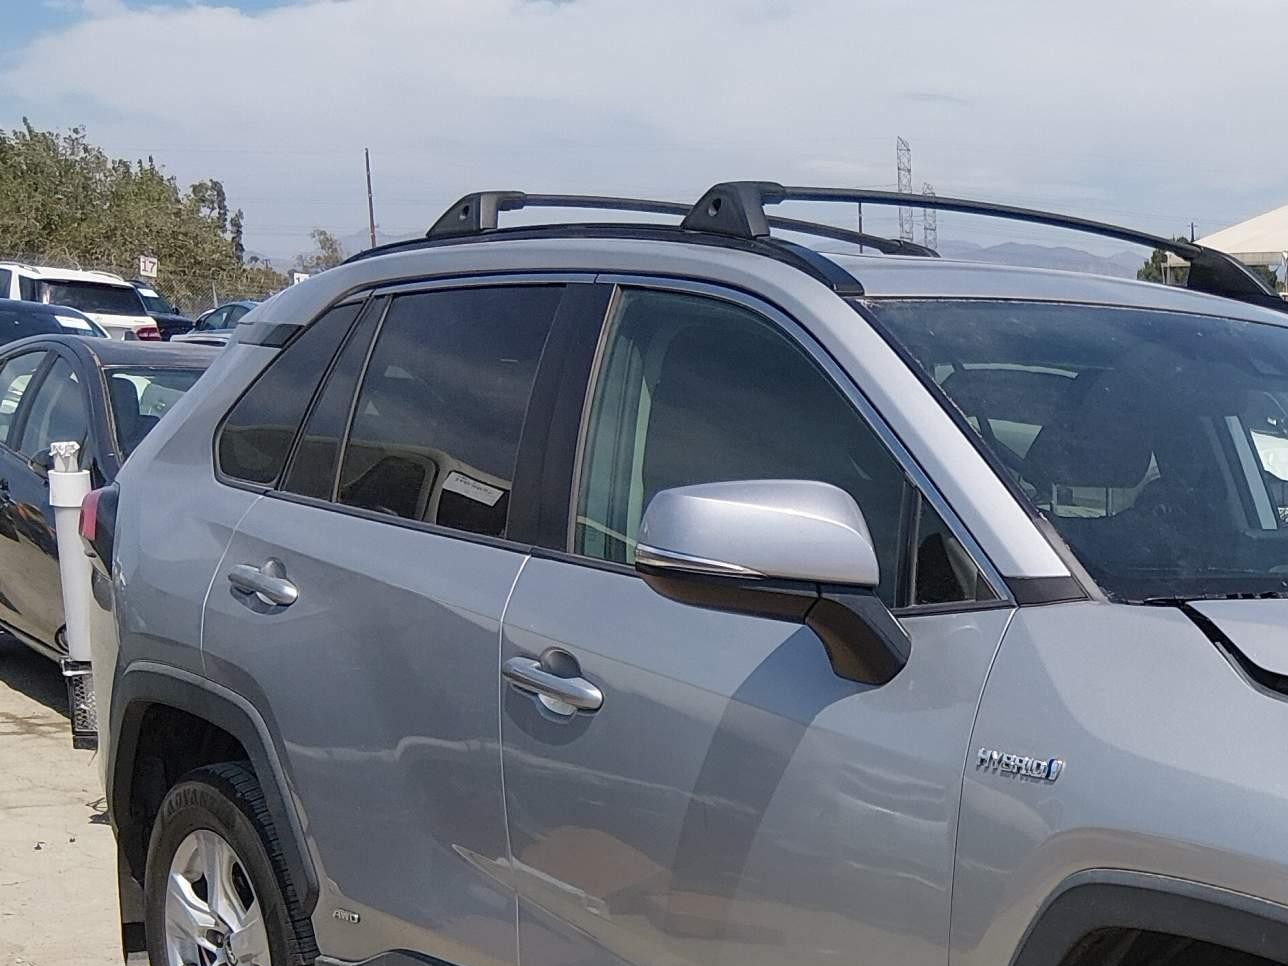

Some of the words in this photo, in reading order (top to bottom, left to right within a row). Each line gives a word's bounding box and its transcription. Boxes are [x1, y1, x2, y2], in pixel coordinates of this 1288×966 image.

[141, 259, 157, 273] 17
[976, 748, 1049, 778] HYBRID
[332, 909, 360, 924] AWD
